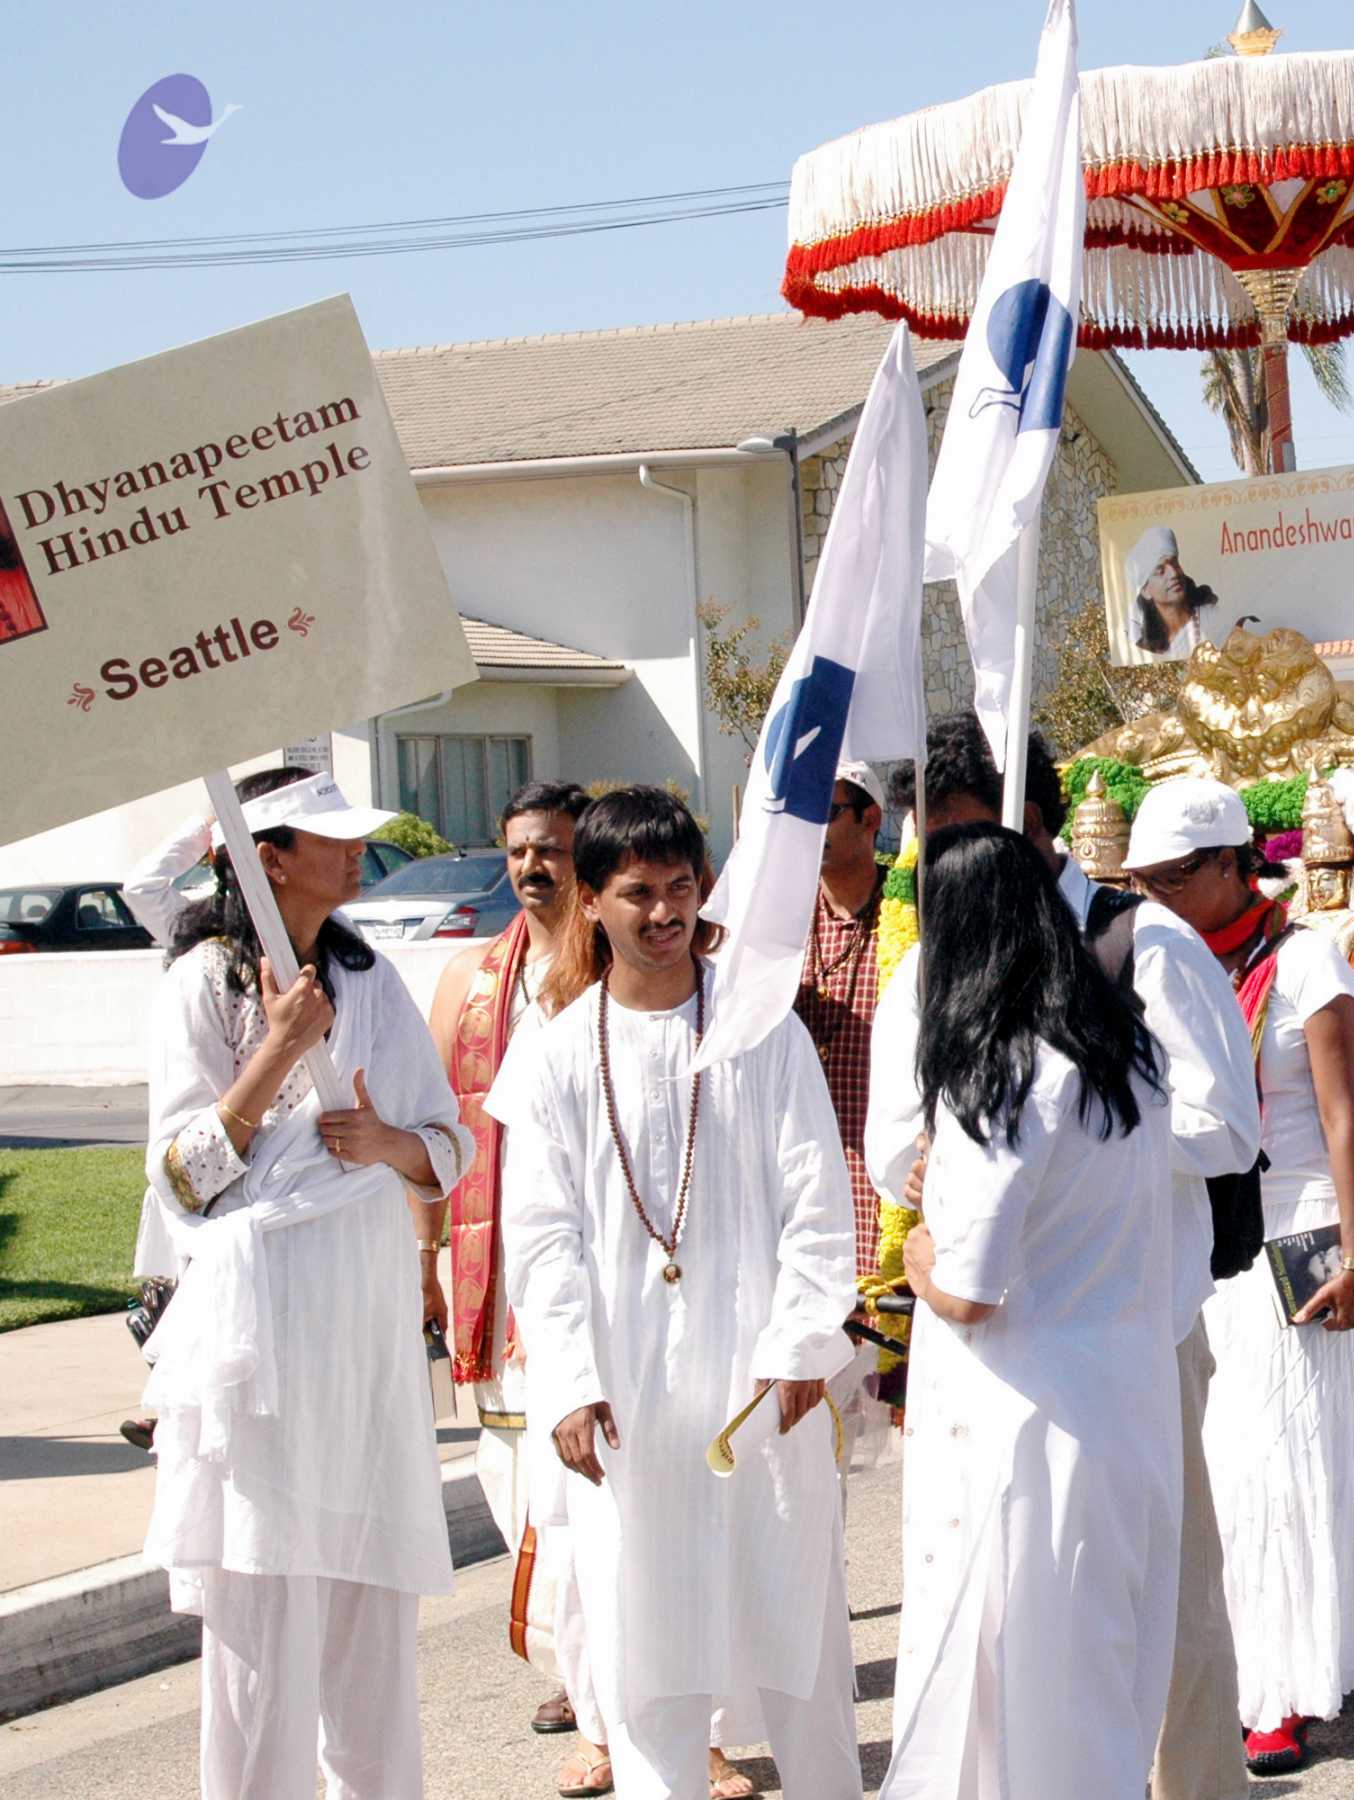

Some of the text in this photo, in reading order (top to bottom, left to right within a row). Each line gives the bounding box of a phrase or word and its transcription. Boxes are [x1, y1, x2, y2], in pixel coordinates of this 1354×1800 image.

[14, 396, 362, 530] Dhyanapeetam
[37, 442, 372, 576] Hindu Temple
[100, 617, 280, 701] Seattle
